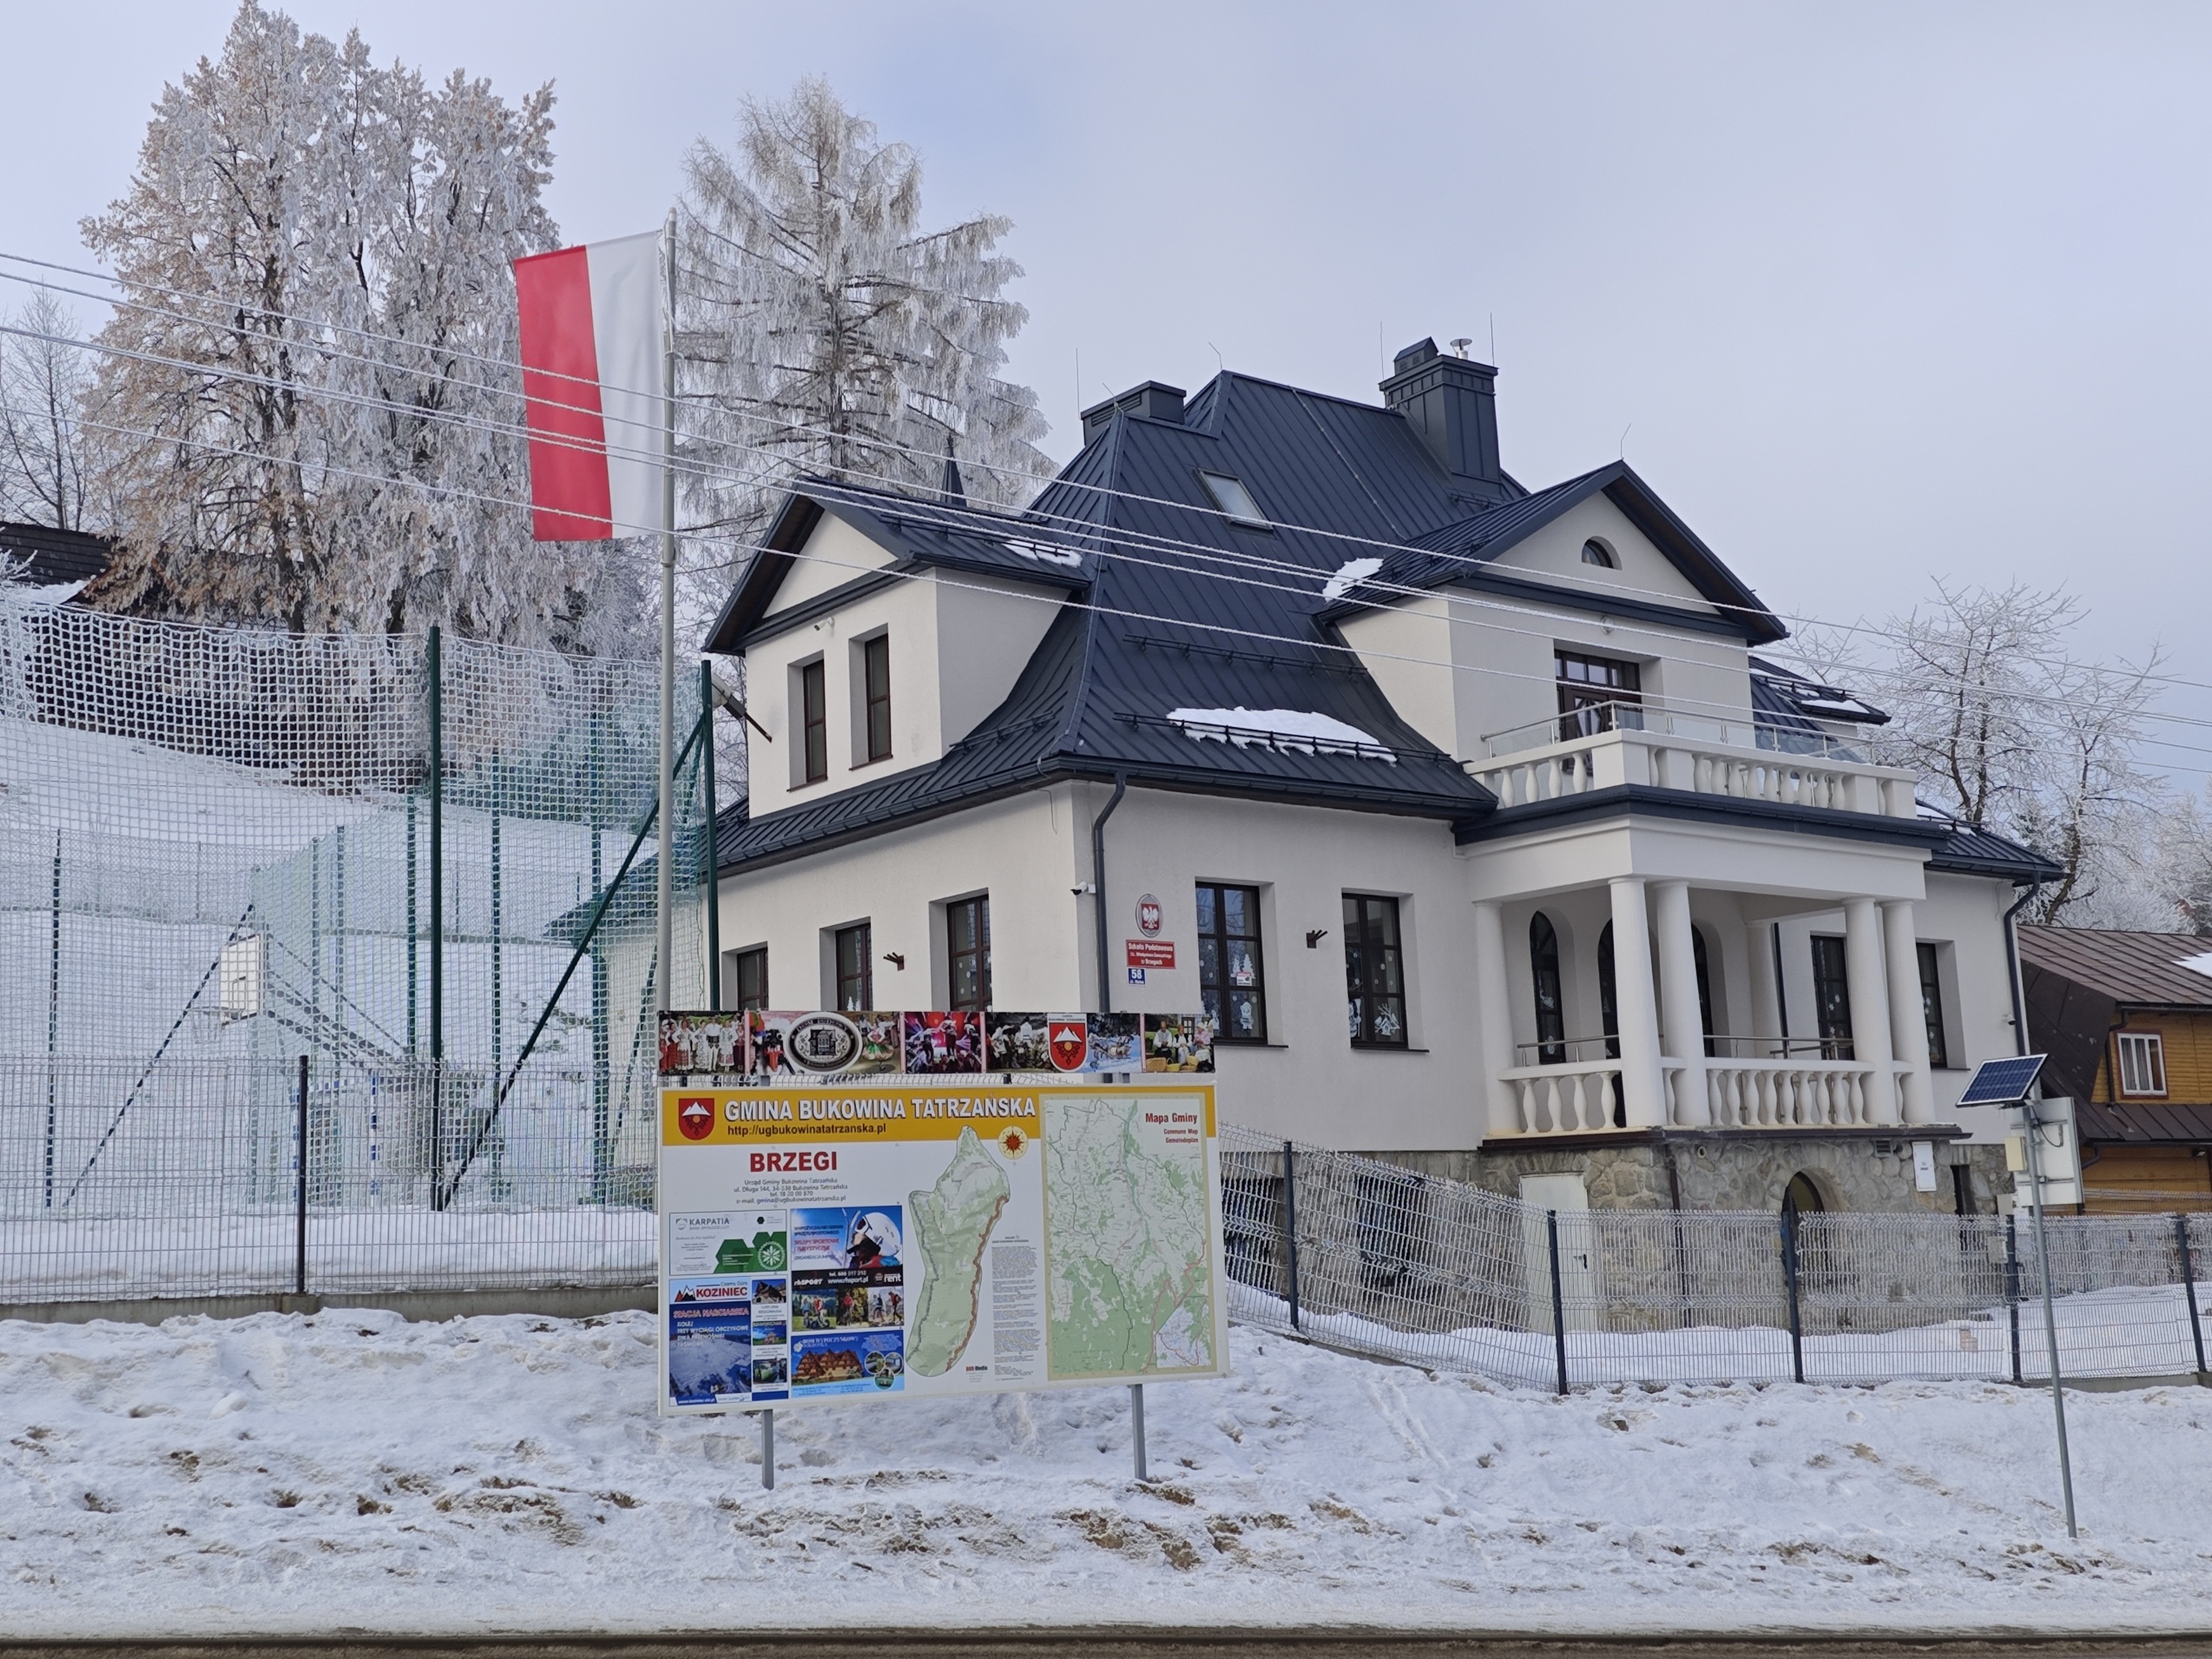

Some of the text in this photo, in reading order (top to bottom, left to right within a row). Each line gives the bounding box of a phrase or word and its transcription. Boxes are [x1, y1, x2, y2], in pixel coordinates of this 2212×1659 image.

[1131, 969, 1143, 979] 58
[724, 1093, 1036, 1121] GMINA BUKOWINA TATRZAŃSKA
[1145, 1112, 1198, 1124] Mapa Gminy
[727, 1123, 886, 1138] http://ugbukowinatatrzanska.pl
[750, 1151, 837, 1172] BRZEGI
[756, 1195, 846, 1205] gmina@ugbukowinatatrzanska.pl
[689, 1217, 730, 1226] KARPATIA
[884, 1274, 902, 1283] rent
[696, 1287, 748, 1298] KOZINIEC
